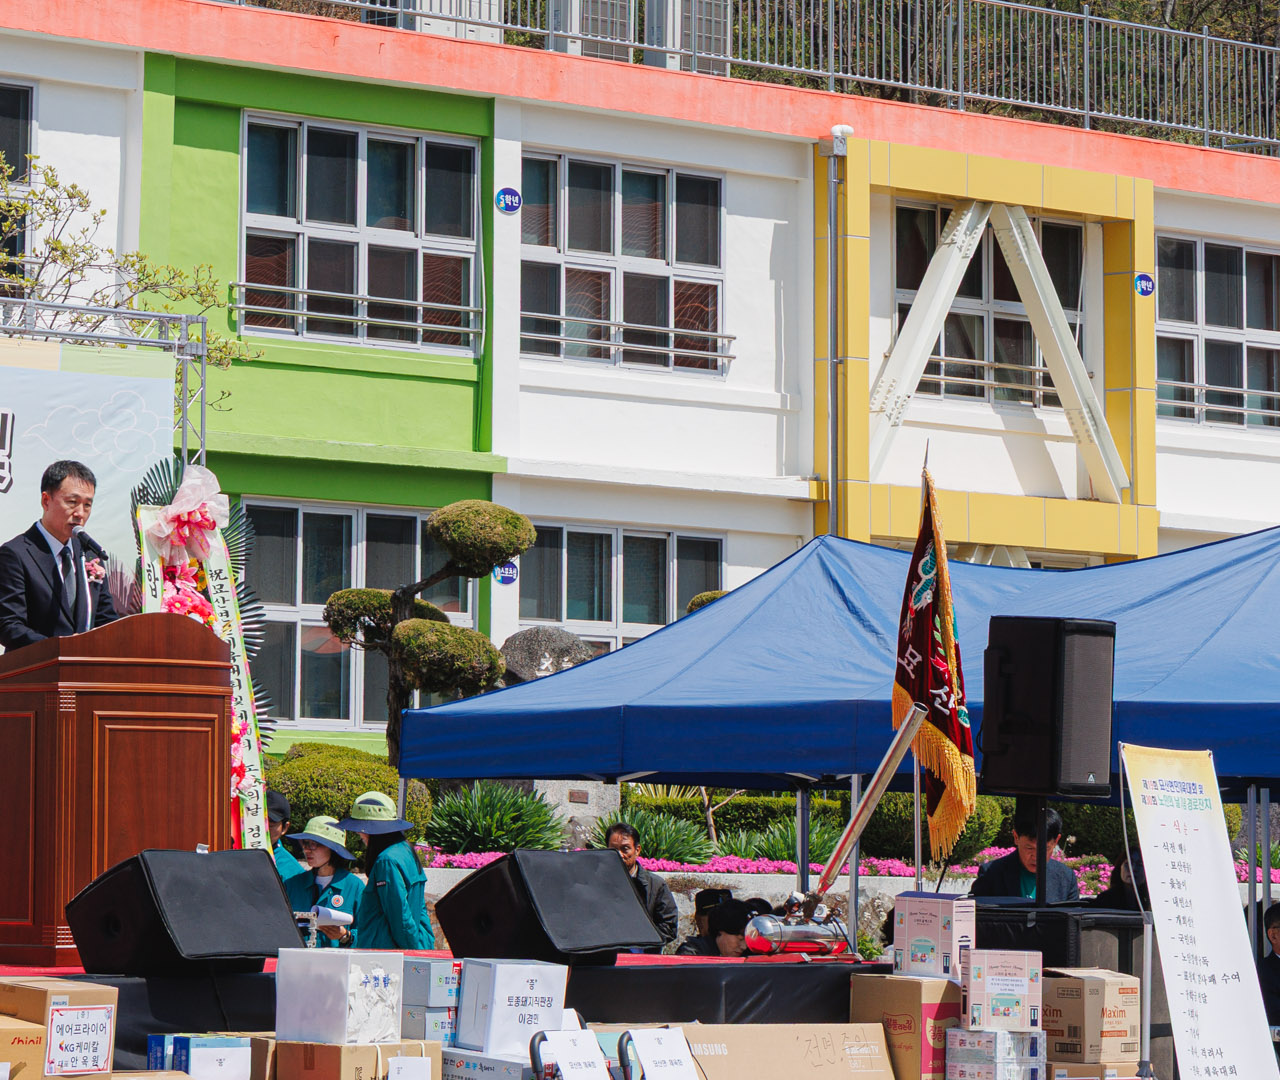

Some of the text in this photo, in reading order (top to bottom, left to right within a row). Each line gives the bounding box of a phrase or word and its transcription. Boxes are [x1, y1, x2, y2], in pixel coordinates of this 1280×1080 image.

[499, 194, 519, 206] 5학년
[1221, 972, 1241, 984] 수여
[507, 996, 554, 1008] 토종돼지직판장
[1042, 1004, 1063, 1018] xim
[1101, 1005, 1126, 1018] Maxim
[56, 1022, 107, 1036] 에어프라이어
[11, 1036, 42, 1046] Shinil
[694, 1043, 728, 1056] MSUNG
